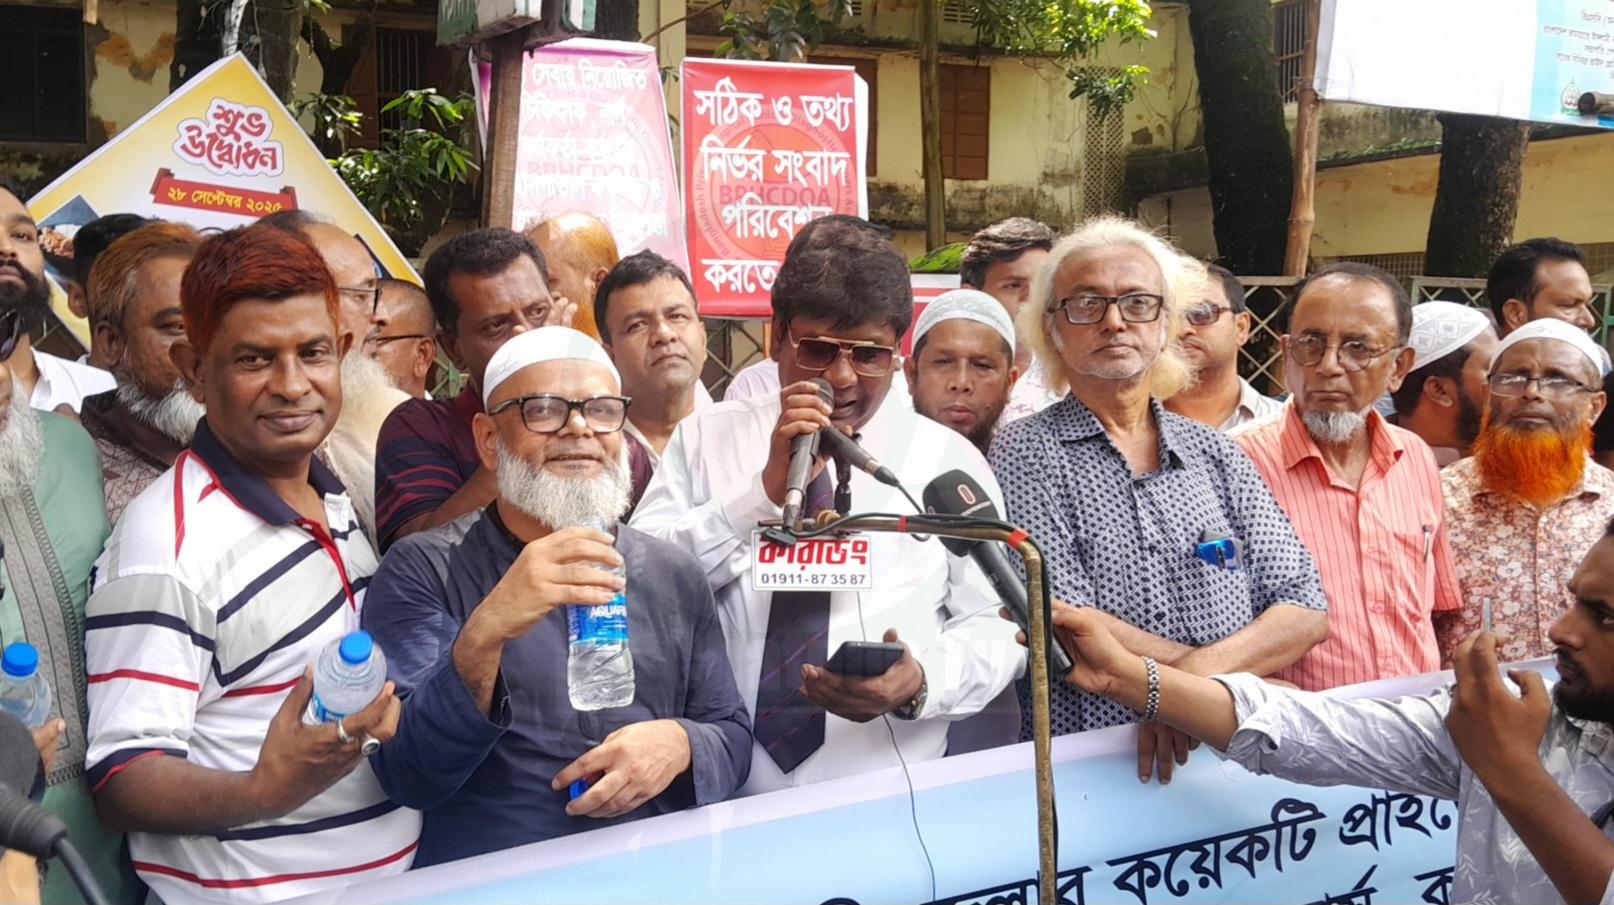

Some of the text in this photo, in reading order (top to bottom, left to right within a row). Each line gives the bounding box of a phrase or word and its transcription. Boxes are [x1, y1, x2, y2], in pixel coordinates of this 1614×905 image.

[213, 105, 266, 142] শুভ
[693, 76, 853, 132] সঠিক ও তথ্য
[180, 125, 278, 170] উদ্বোধন
[699, 133, 767, 184] নির্ভর
[771, 148, 851, 188] সংবাদ
[168, 187, 187, 202] ২৮
[191, 189, 243, 209] সেপ্টেম্বর
[721, 191, 834, 240] পরিবেশ
[1105, 797, 1327, 905] কয়েকটি
